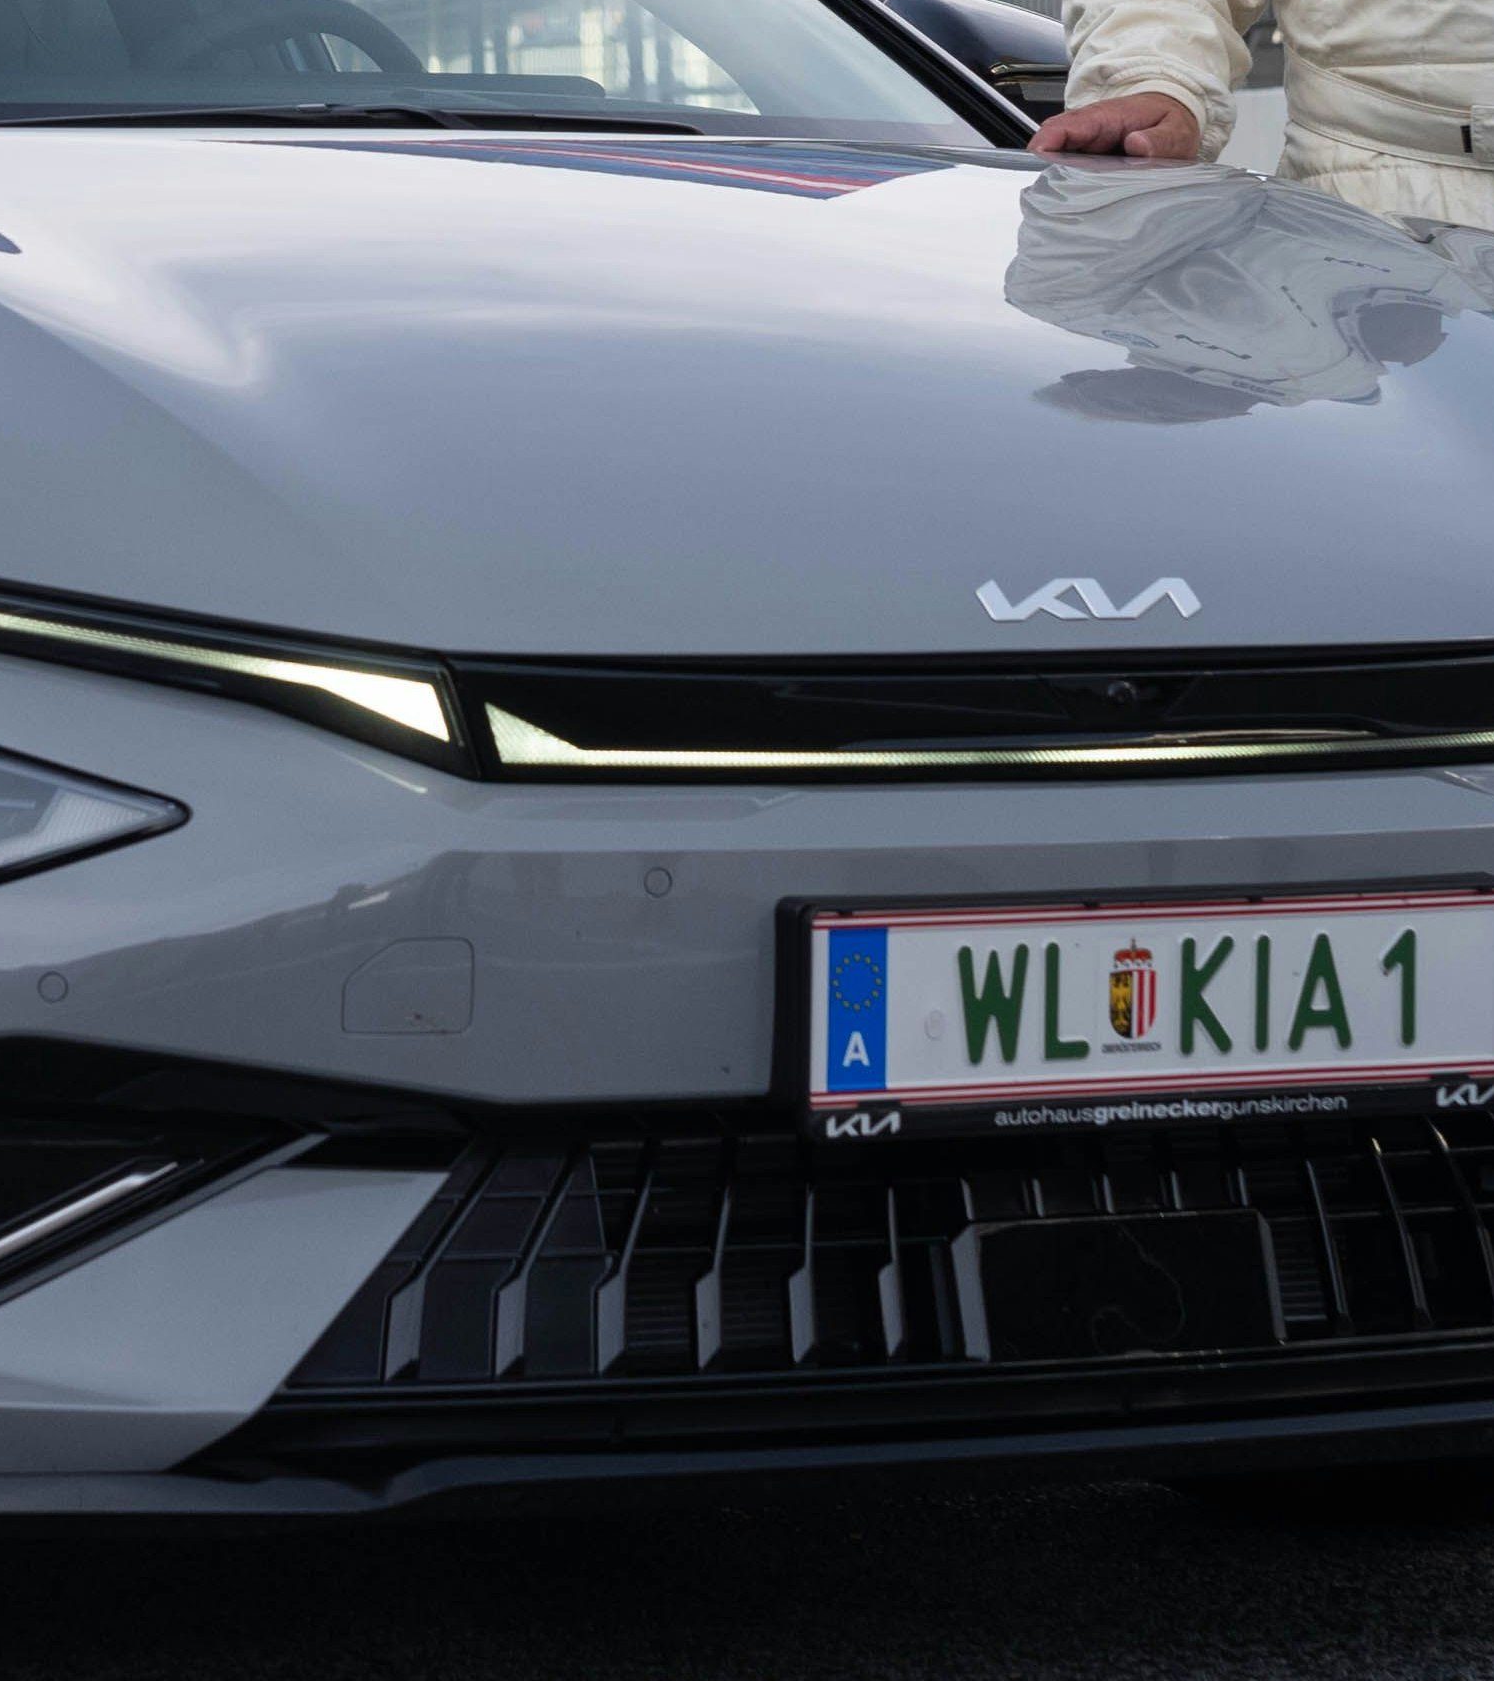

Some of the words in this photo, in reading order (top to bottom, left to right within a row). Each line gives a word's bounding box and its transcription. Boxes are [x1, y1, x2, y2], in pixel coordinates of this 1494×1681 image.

[975, 577, 1202, 622] KIA
[957, 941, 1091, 1065] WL
[842, 1030, 871, 1068] A
